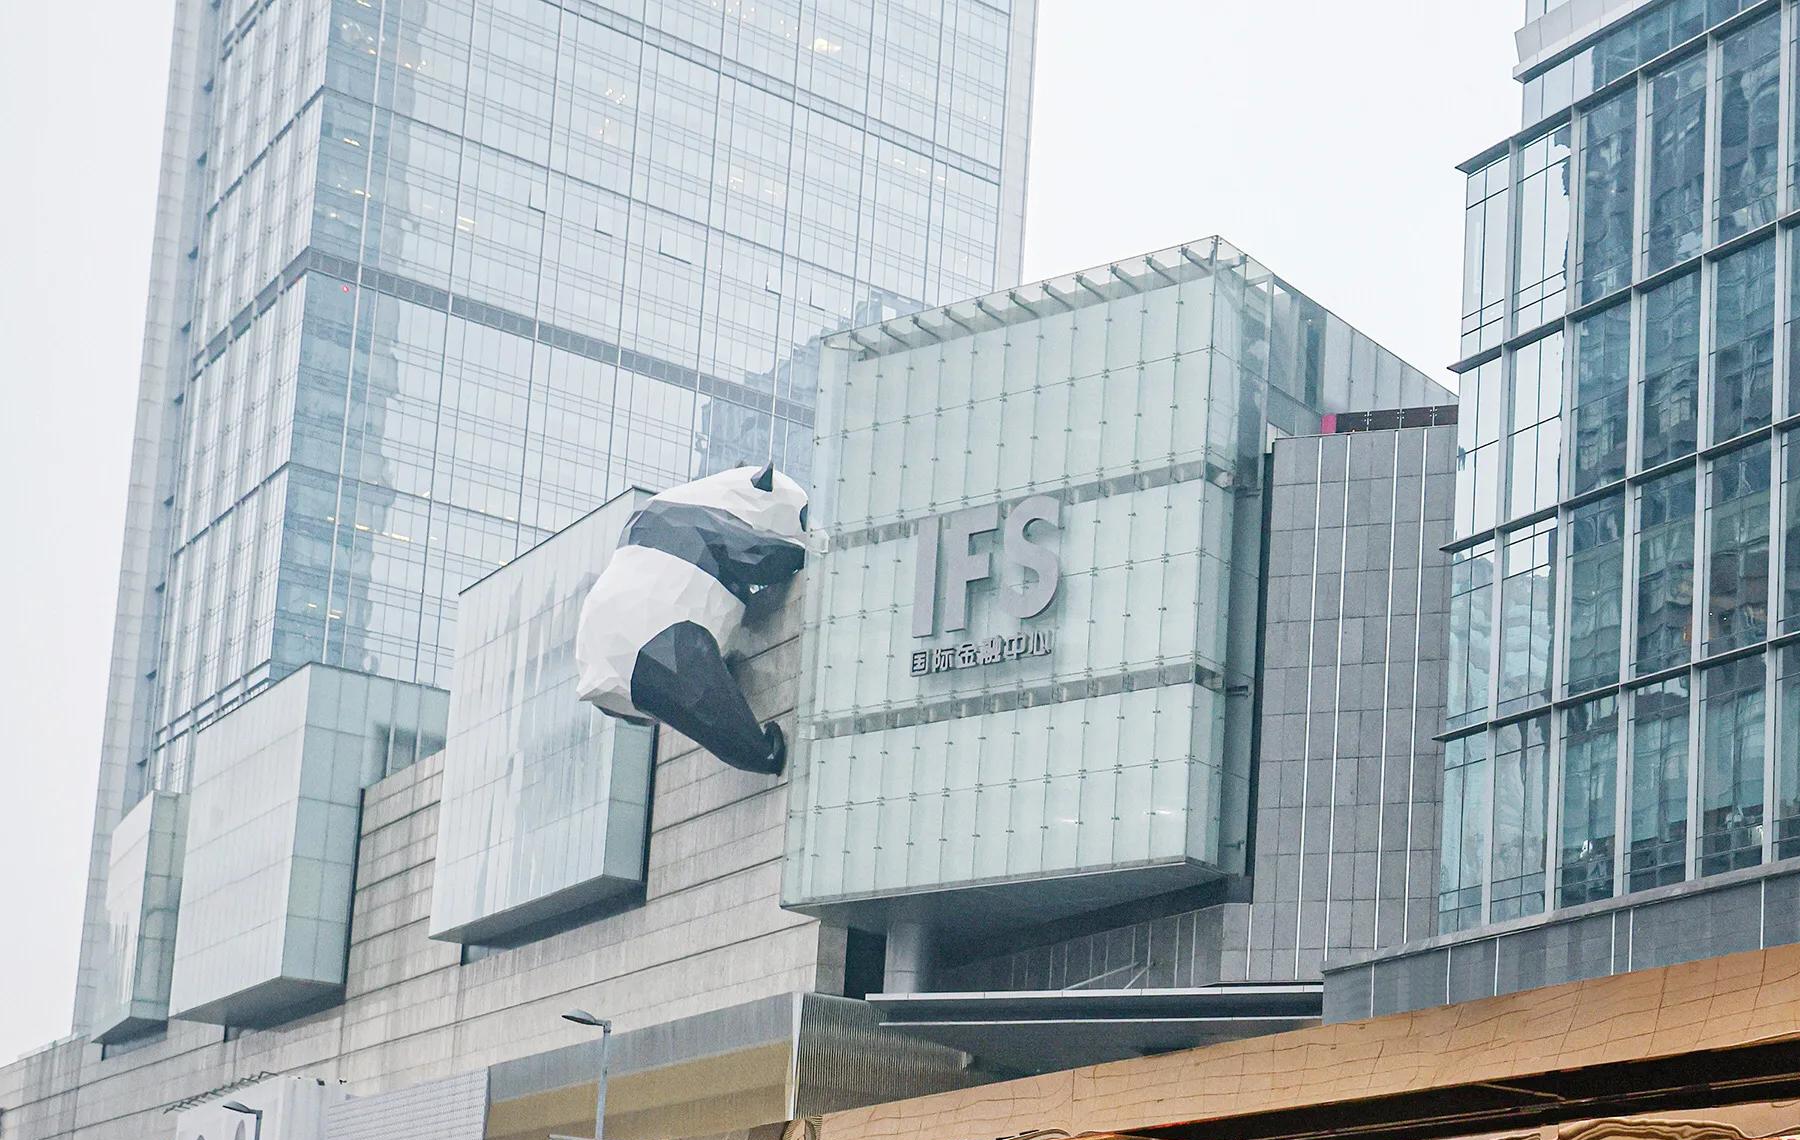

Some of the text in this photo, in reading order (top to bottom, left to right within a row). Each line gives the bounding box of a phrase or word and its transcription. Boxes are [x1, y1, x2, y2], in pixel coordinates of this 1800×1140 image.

[912, 495, 1060, 638] IFS
[911, 630, 1054, 677] 国际金融中心
